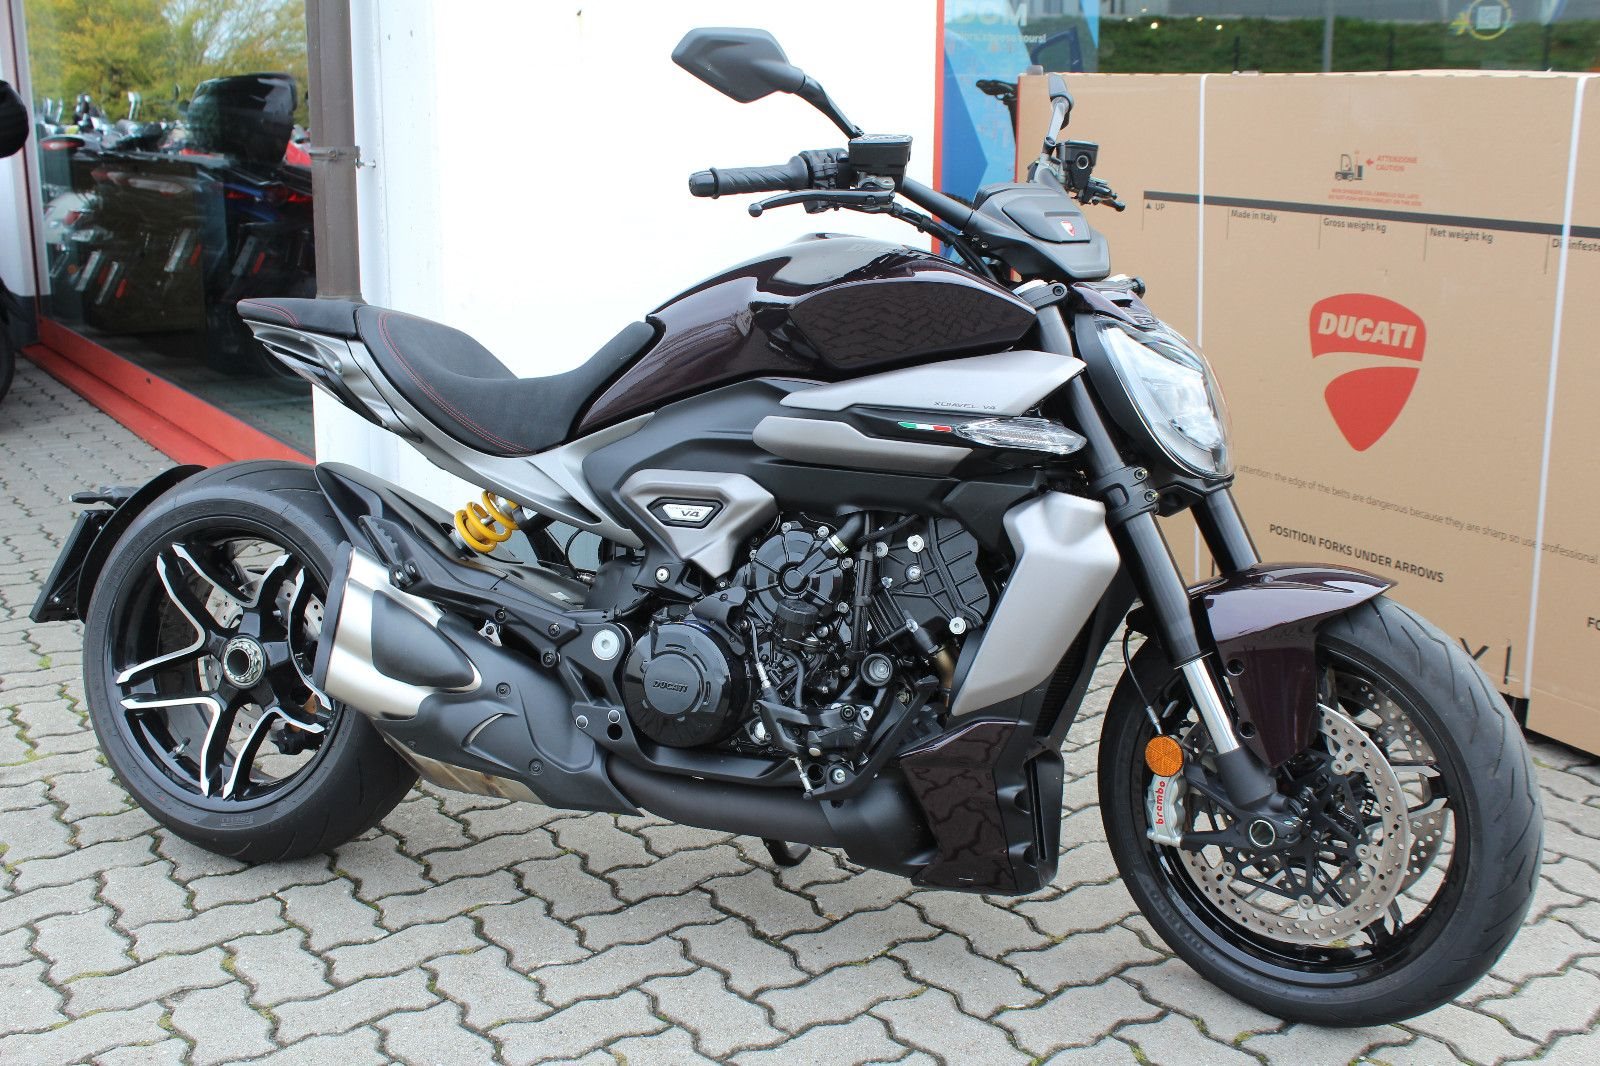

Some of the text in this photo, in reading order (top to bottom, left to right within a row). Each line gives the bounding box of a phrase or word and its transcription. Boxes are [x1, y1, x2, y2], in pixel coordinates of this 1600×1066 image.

[1155, 203, 1165, 211] UP
[1231, 209, 1277, 223] Made in Italy
[1323, 217, 1387, 234] Gross weight kg
[1430, 227, 1494, 244] Net weight kg
[1552, 238, 1600, 251] Diinfest
[1318, 311, 1417, 349] DUCATI
[1274, 471, 1287, 482] the
[1288, 476, 1306, 489] edge
[1308, 480, 1317, 490] of
[1318, 483, 1331, 494] the
[1332, 486, 1350, 499] belts
[1352, 494, 1364, 503] are
[1366, 495, 1408, 514] dangerous
[1410, 506, 1444, 523] because
[1445, 516, 1465, 531] they
[1466, 523, 1481, 533] are
[1482, 526, 1507, 541] sharp
[1509, 534, 1520, 544] so
[1522, 538, 1537, 549] use
[1269, 523, 1445, 583] POSITION FORKS UNDER ARROWS
[652, 680, 689, 693] DUCATI
[1155, 780, 1166, 825] brembo
